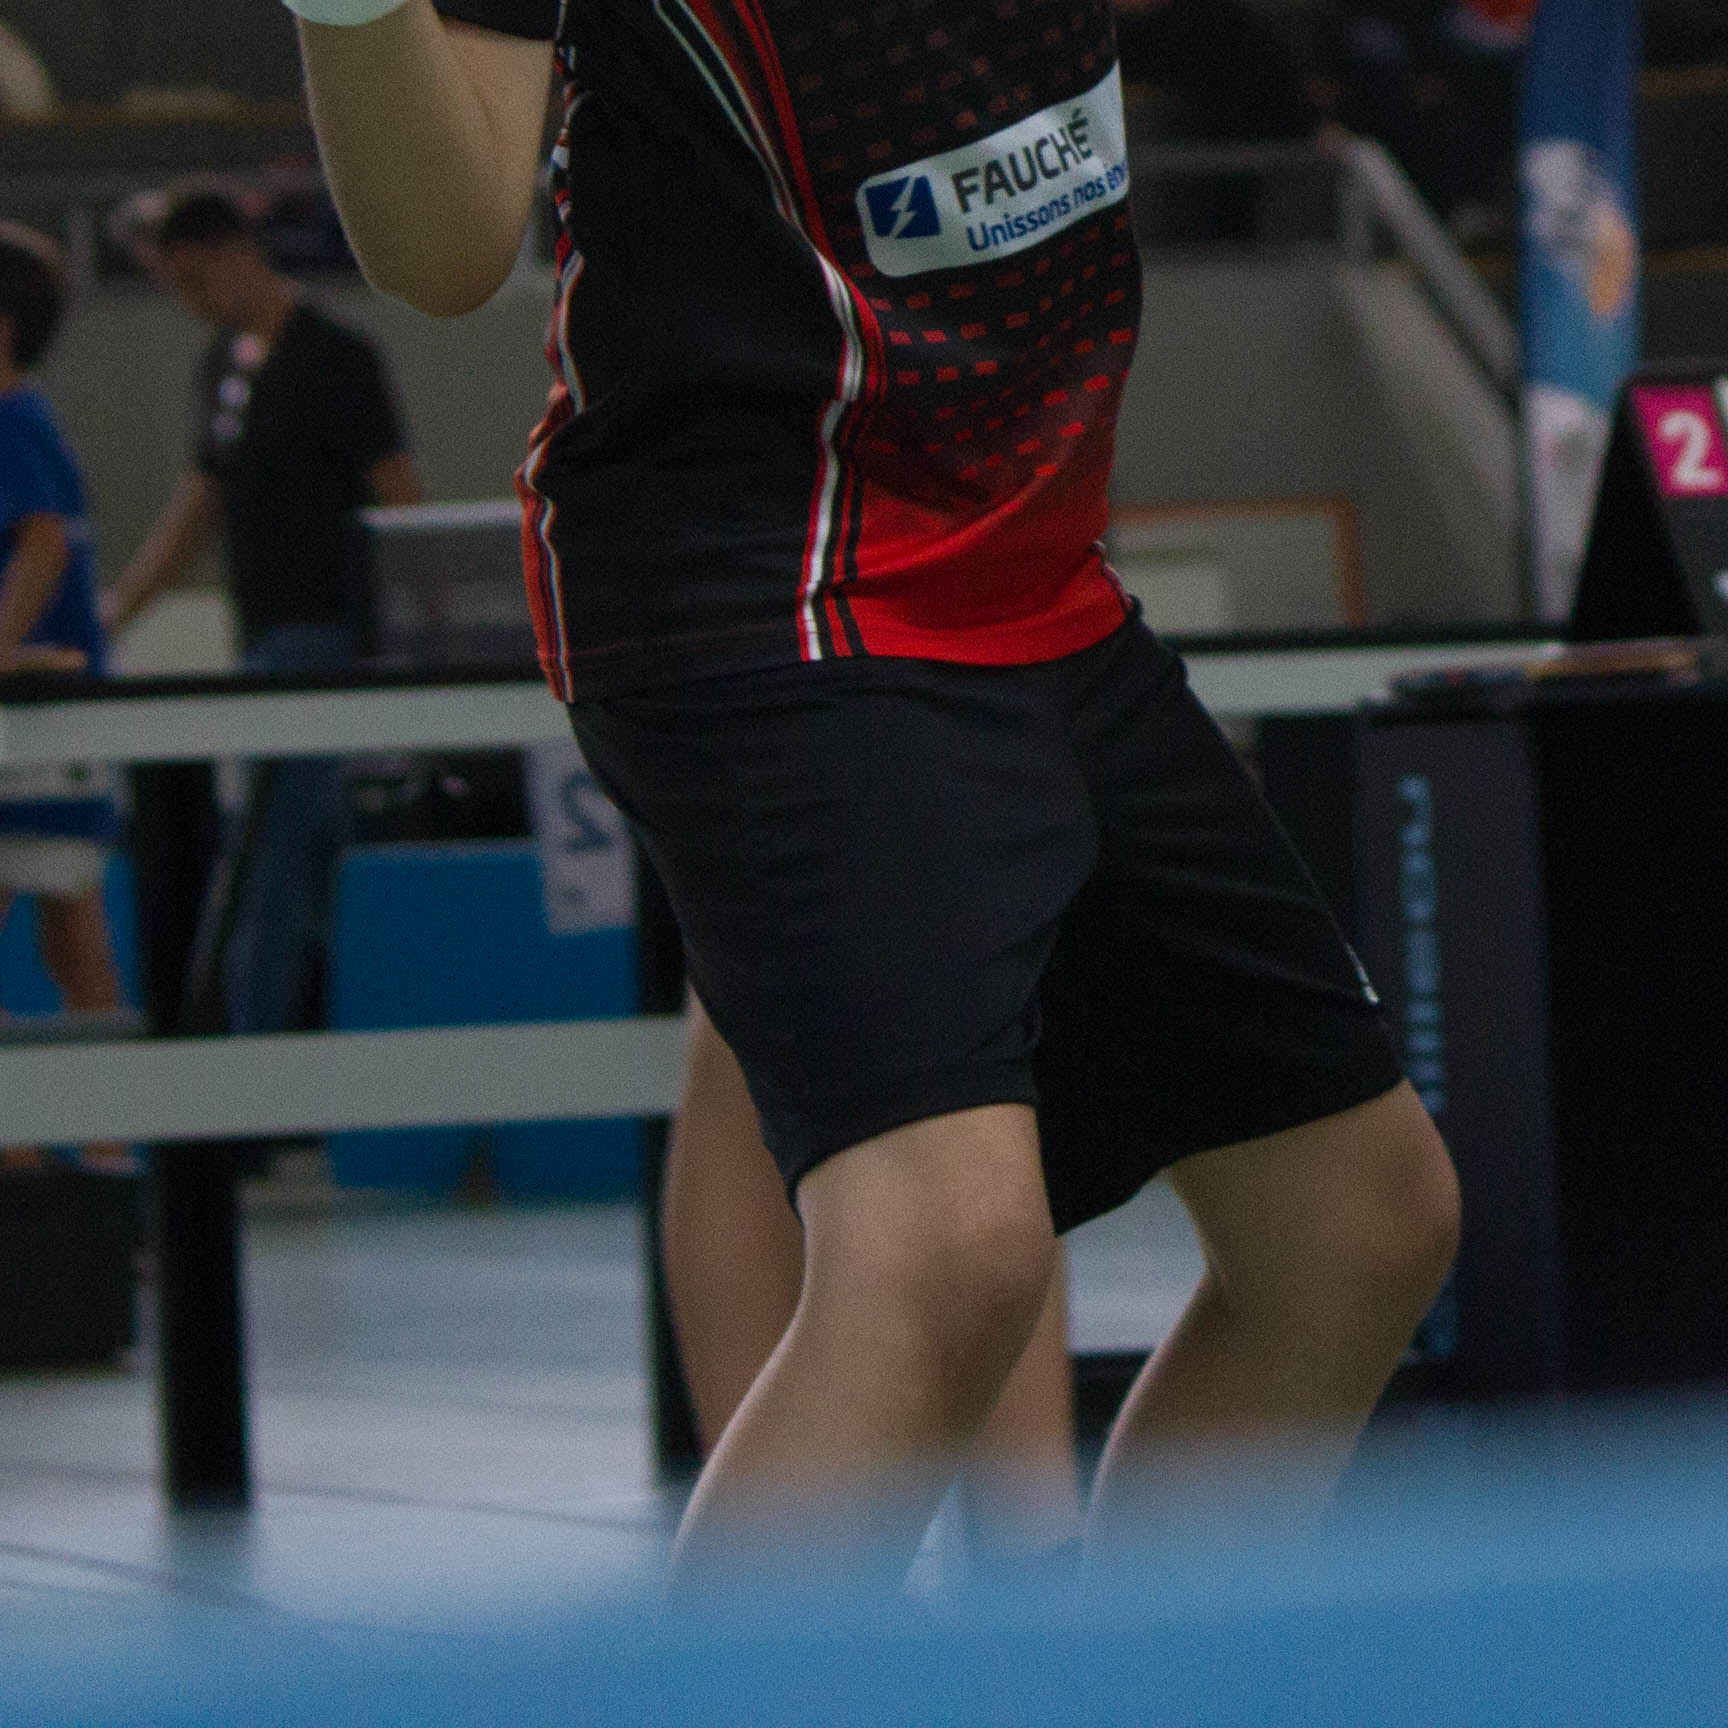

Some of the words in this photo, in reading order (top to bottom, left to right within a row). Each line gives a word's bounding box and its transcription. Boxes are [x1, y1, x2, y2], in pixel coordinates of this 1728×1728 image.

[951, 106, 1094, 213] FAUCHÉ
[967, 192, 1071, 251] Unissons
[1073, 176, 1106, 209] nos
[1656, 408, 1725, 491] 2
